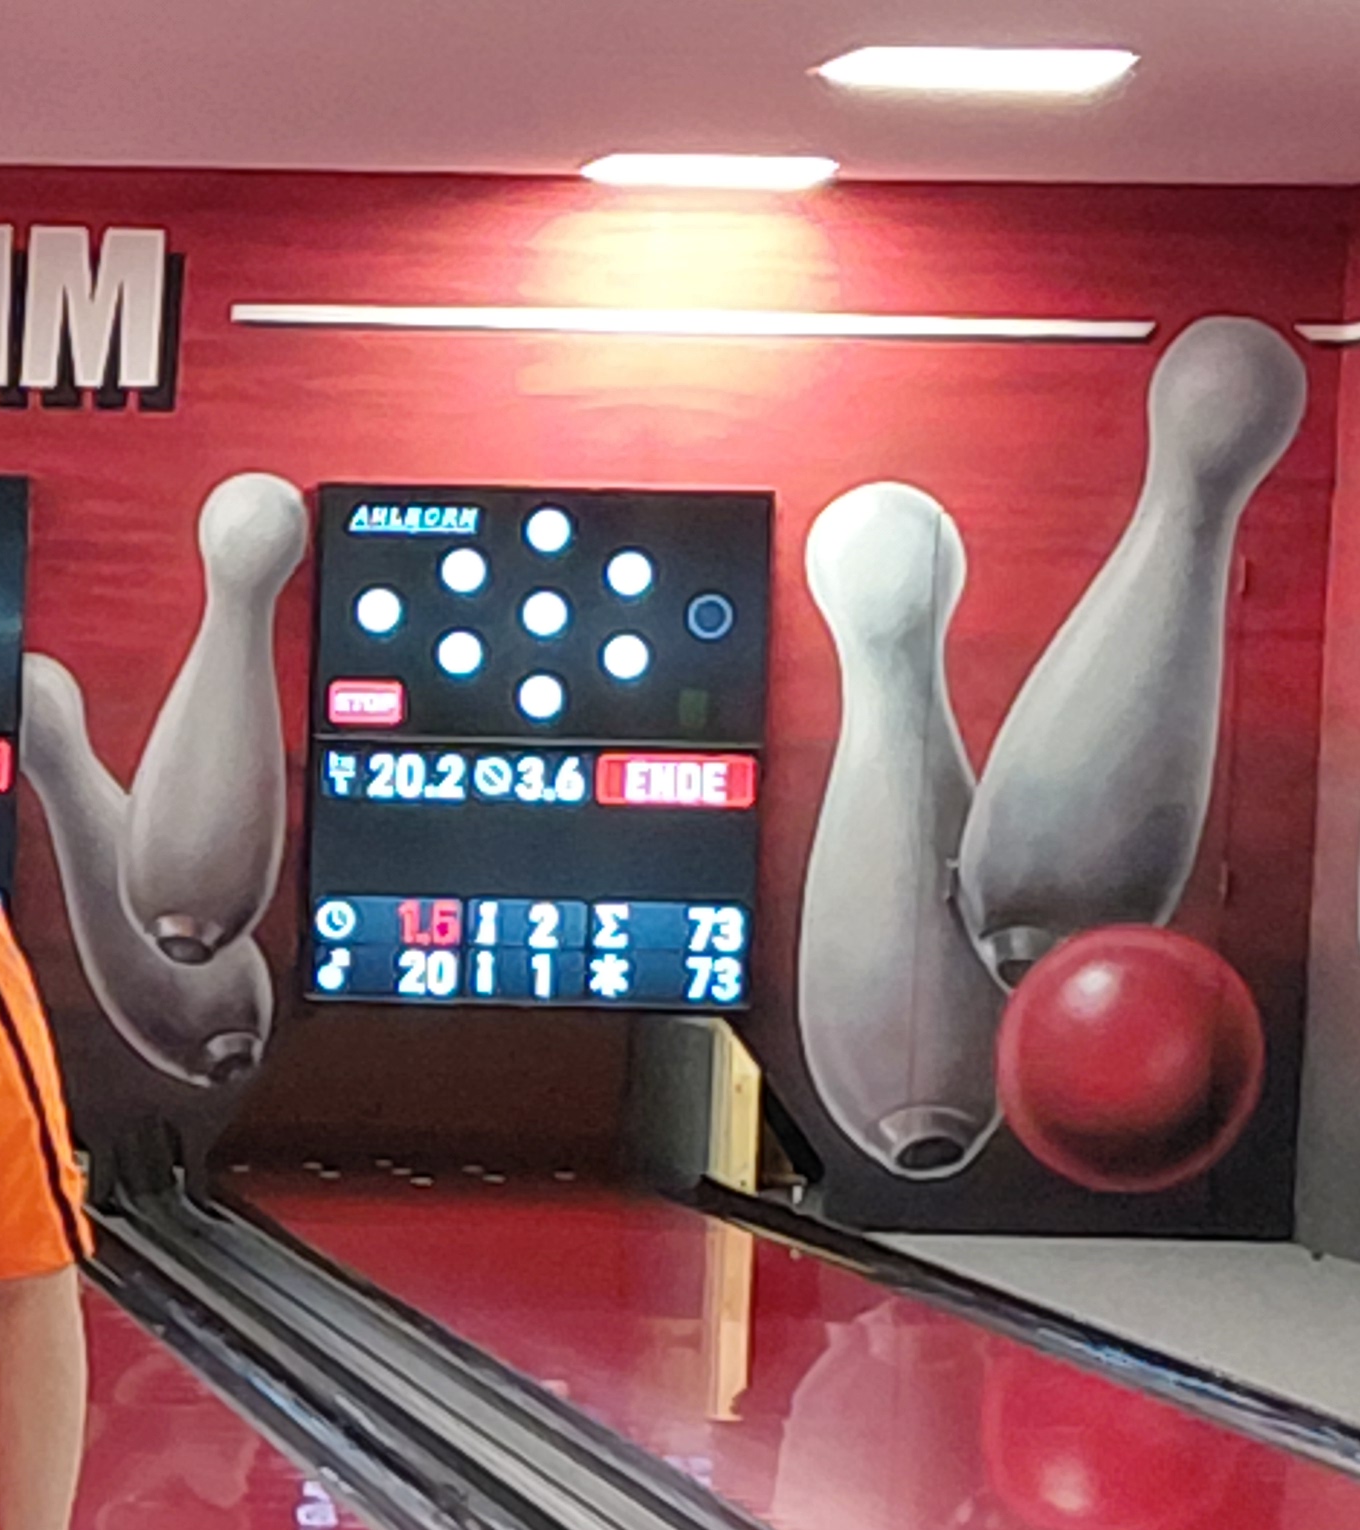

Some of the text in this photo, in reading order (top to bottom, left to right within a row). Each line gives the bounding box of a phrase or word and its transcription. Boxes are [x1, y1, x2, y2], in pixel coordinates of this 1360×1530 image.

[366, 752, 467, 798] 20.2
[514, 756, 586, 802] 3.6
[625, 761, 728, 804] ENDE
[528, 901, 560, 949] 2
[688, 906, 744, 952] 73
[397, 948, 458, 996] 20
[685, 956, 742, 1001] 73
